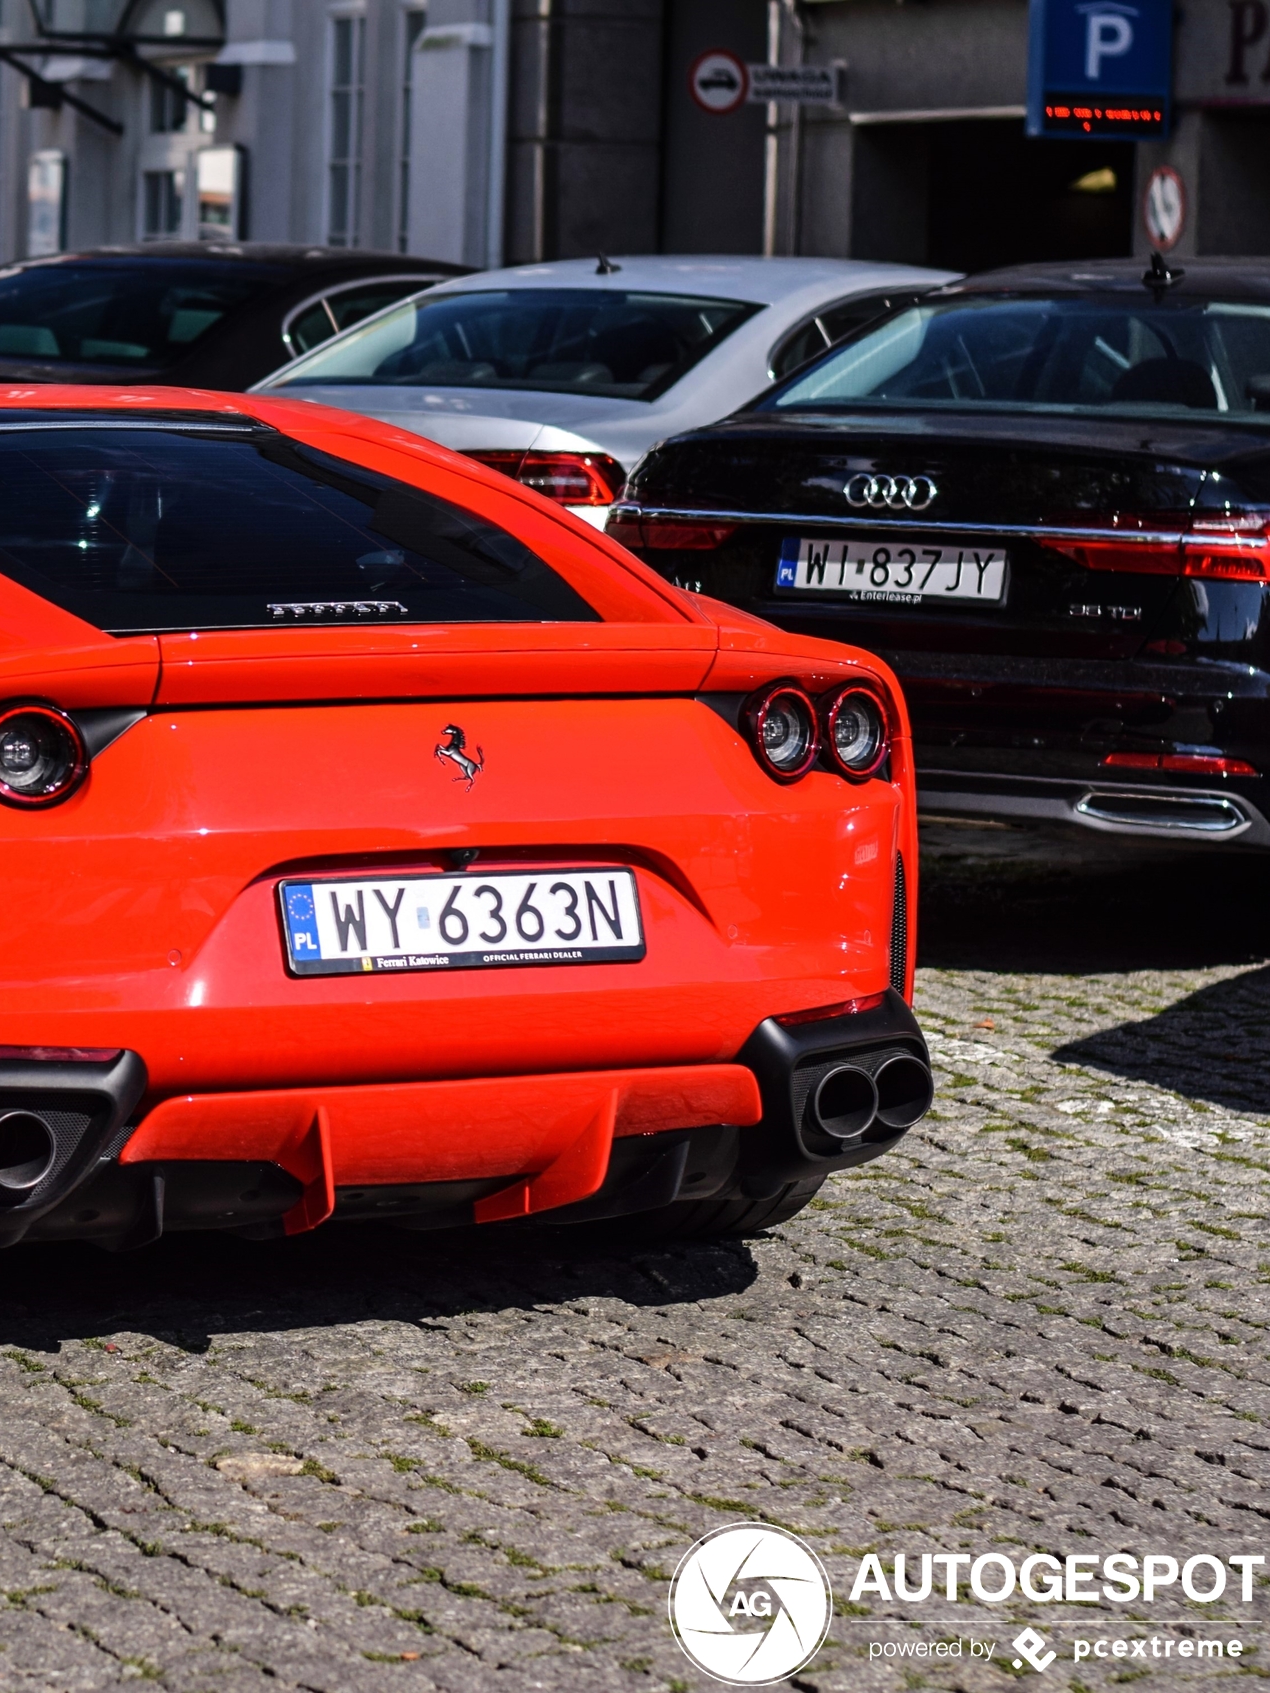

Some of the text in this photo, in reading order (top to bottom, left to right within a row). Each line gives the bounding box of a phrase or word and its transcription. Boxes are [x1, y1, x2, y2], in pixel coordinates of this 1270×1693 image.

[1084, 14, 1134, 81] P
[780, 568, 794, 581] PL
[805, 543, 996, 595] WI 837JY
[860, 590, 922, 605] Enterlease.pl
[329, 880, 624, 952] WY 6363N
[294, 932, 318, 950] PL
[376, 954, 450, 968] Ferrari Katowice
[482, 951, 583, 963] OFFICIAL FERRARI DEALER
